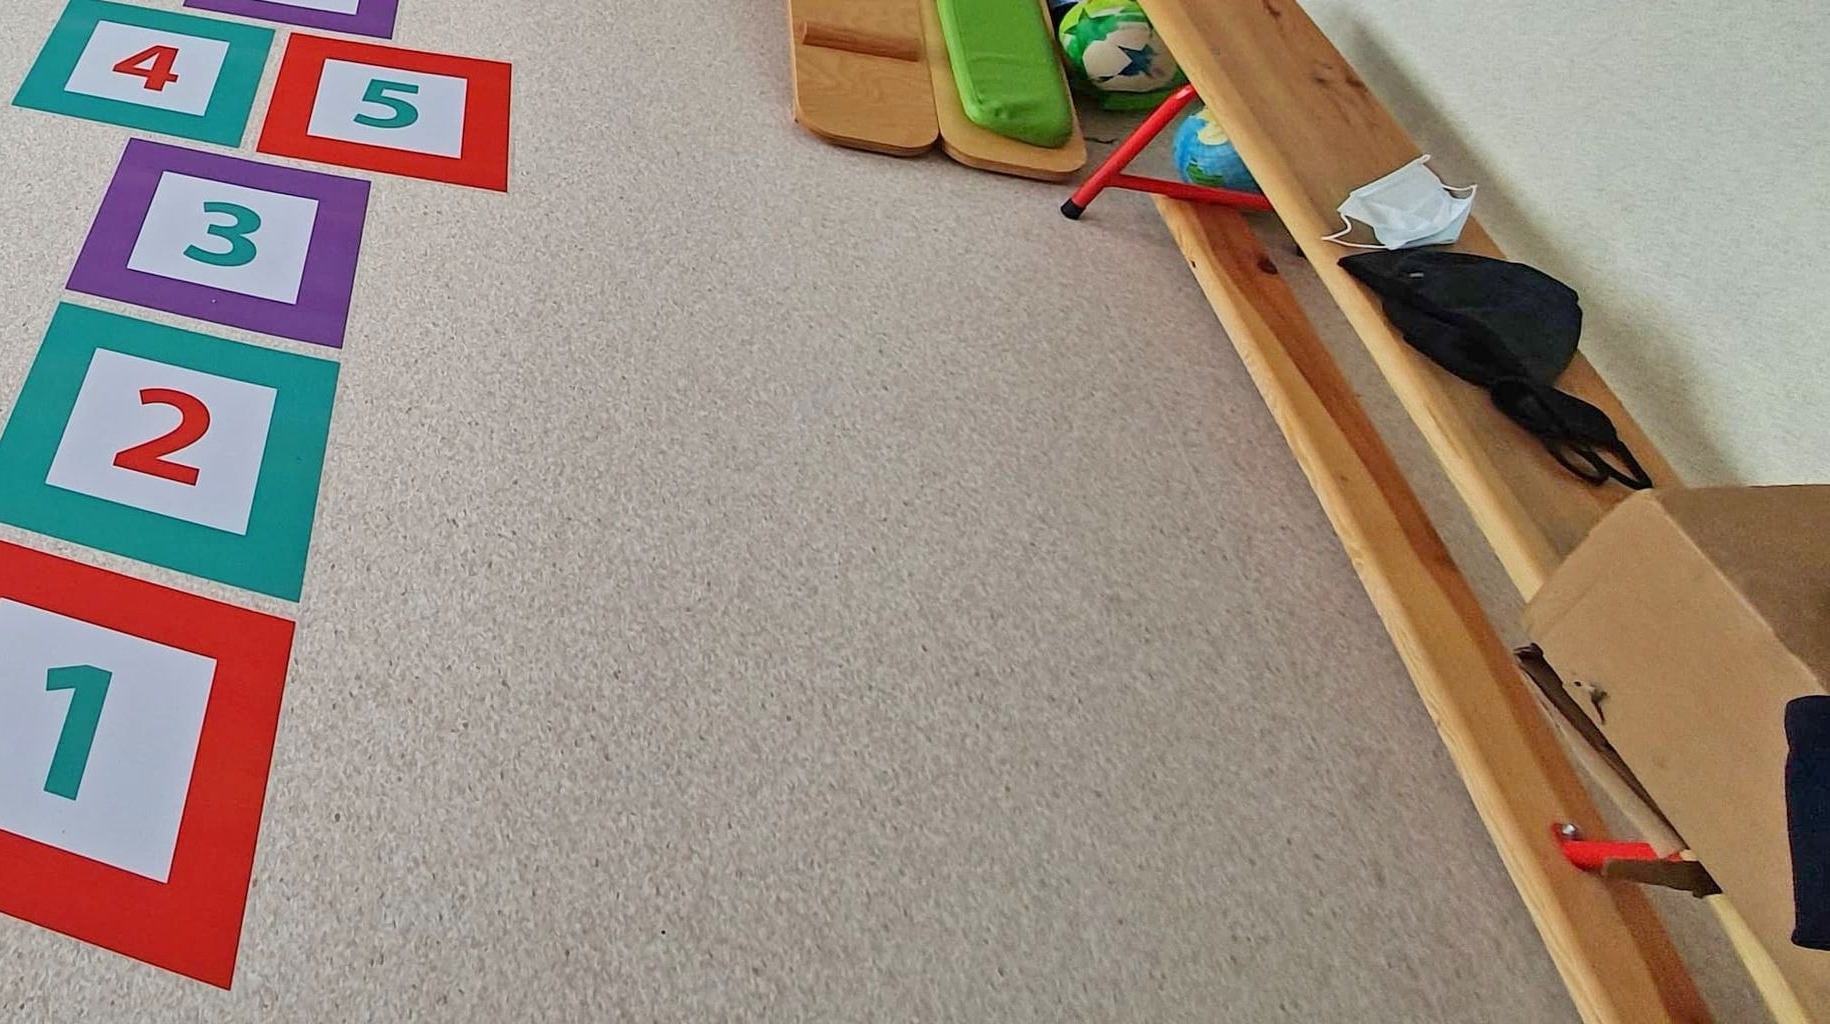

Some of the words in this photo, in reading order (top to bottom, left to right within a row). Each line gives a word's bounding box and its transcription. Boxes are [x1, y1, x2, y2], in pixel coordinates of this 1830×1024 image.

[113, 45, 179, 91] 4
[354, 79, 420, 128] 5
[183, 202, 262, 267] 3
[112, 388, 211, 486] 2
[44, 664, 113, 801] 1
